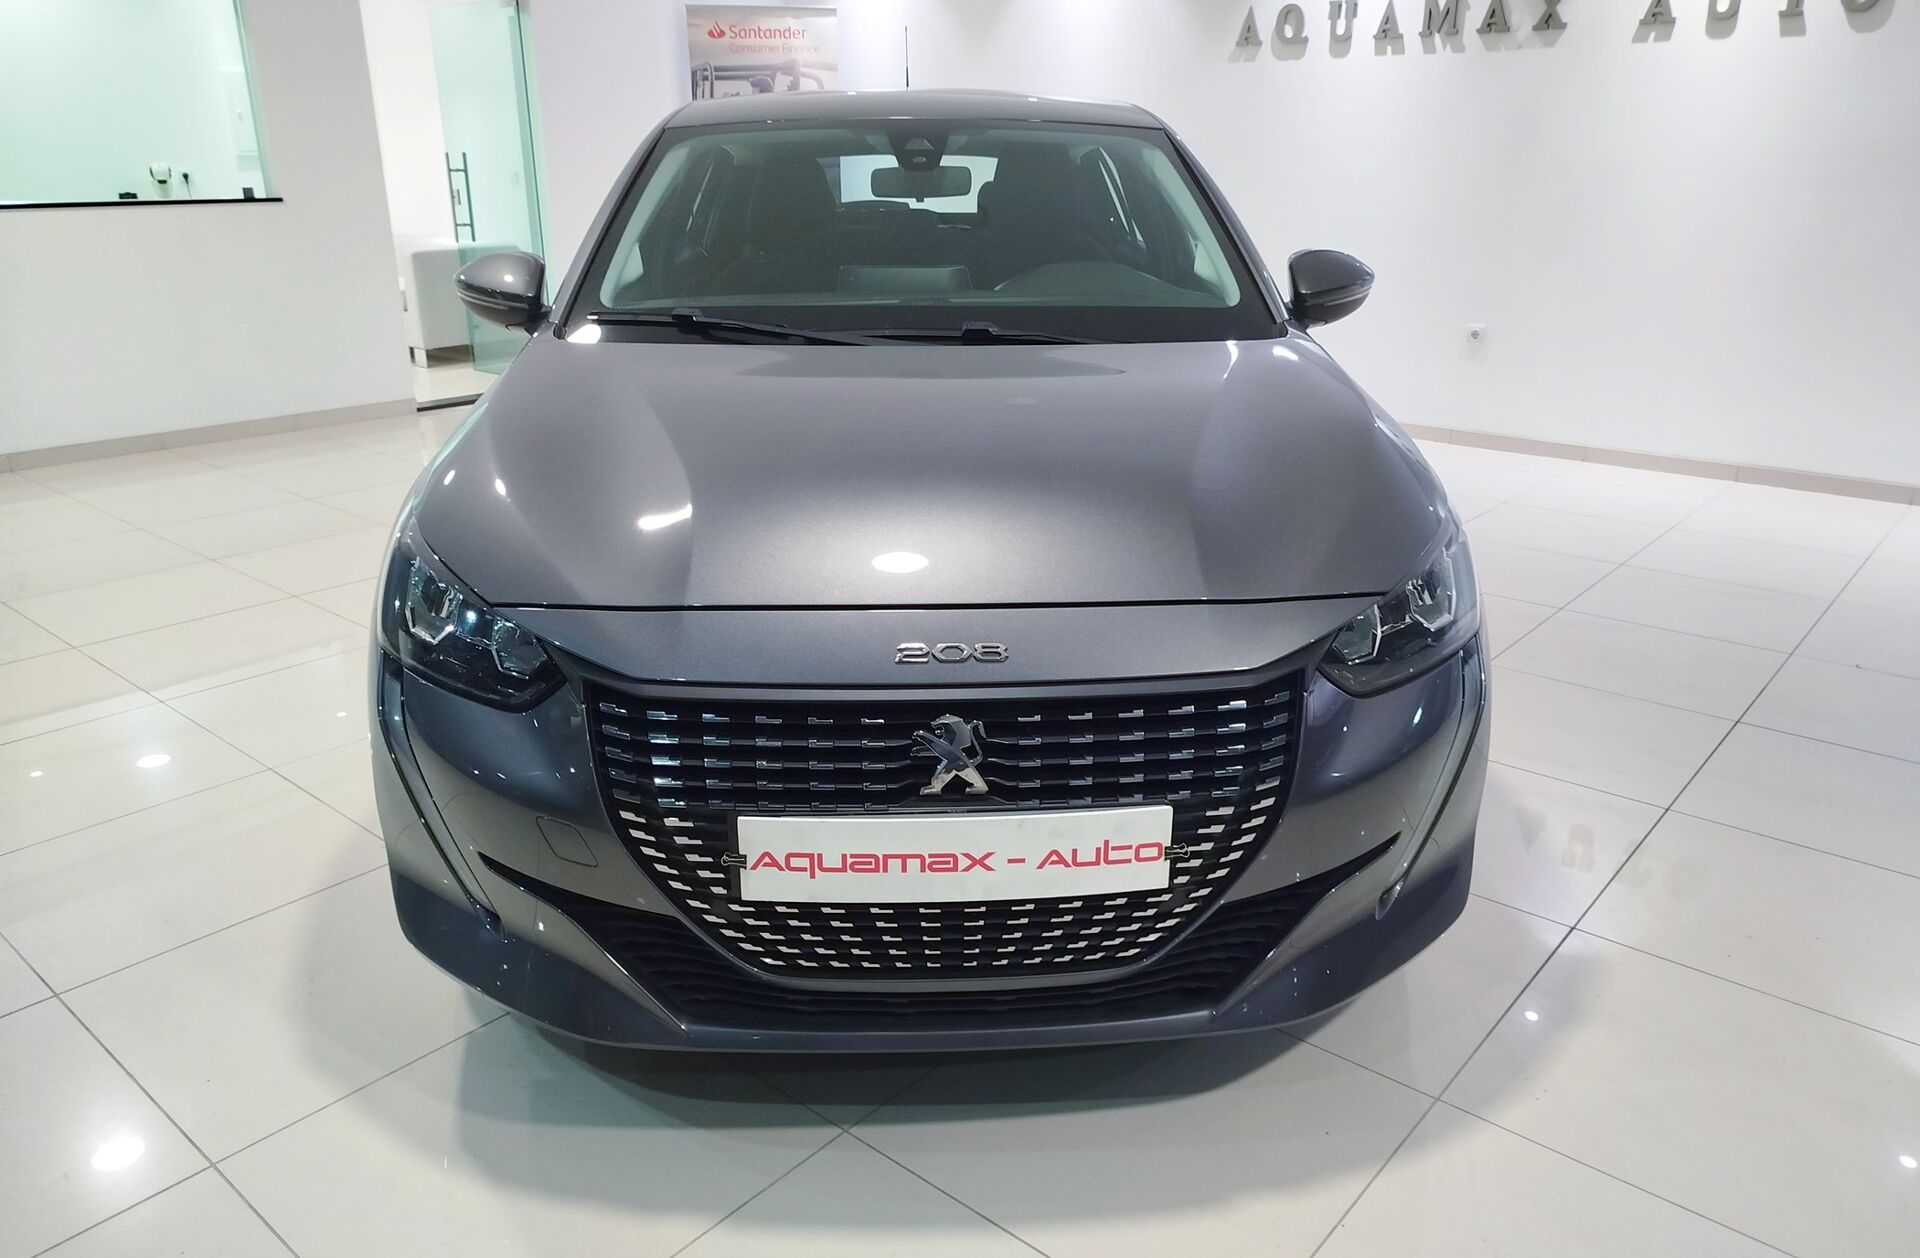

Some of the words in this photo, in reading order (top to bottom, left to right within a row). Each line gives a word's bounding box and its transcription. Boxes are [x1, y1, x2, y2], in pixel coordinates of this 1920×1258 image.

[728, 25, 807, 40] Santander
[1236, 0, 1568, 46] AQUAMAX
[1639, 0, 1884, 24] AU
[728, 42, 780, 54] Consumer
[782, 43, 820, 54] Finance
[894, 642, 1009, 663] 208
[750, 850, 995, 879] Aquamax
[1036, 840, 1164, 869] Auto
